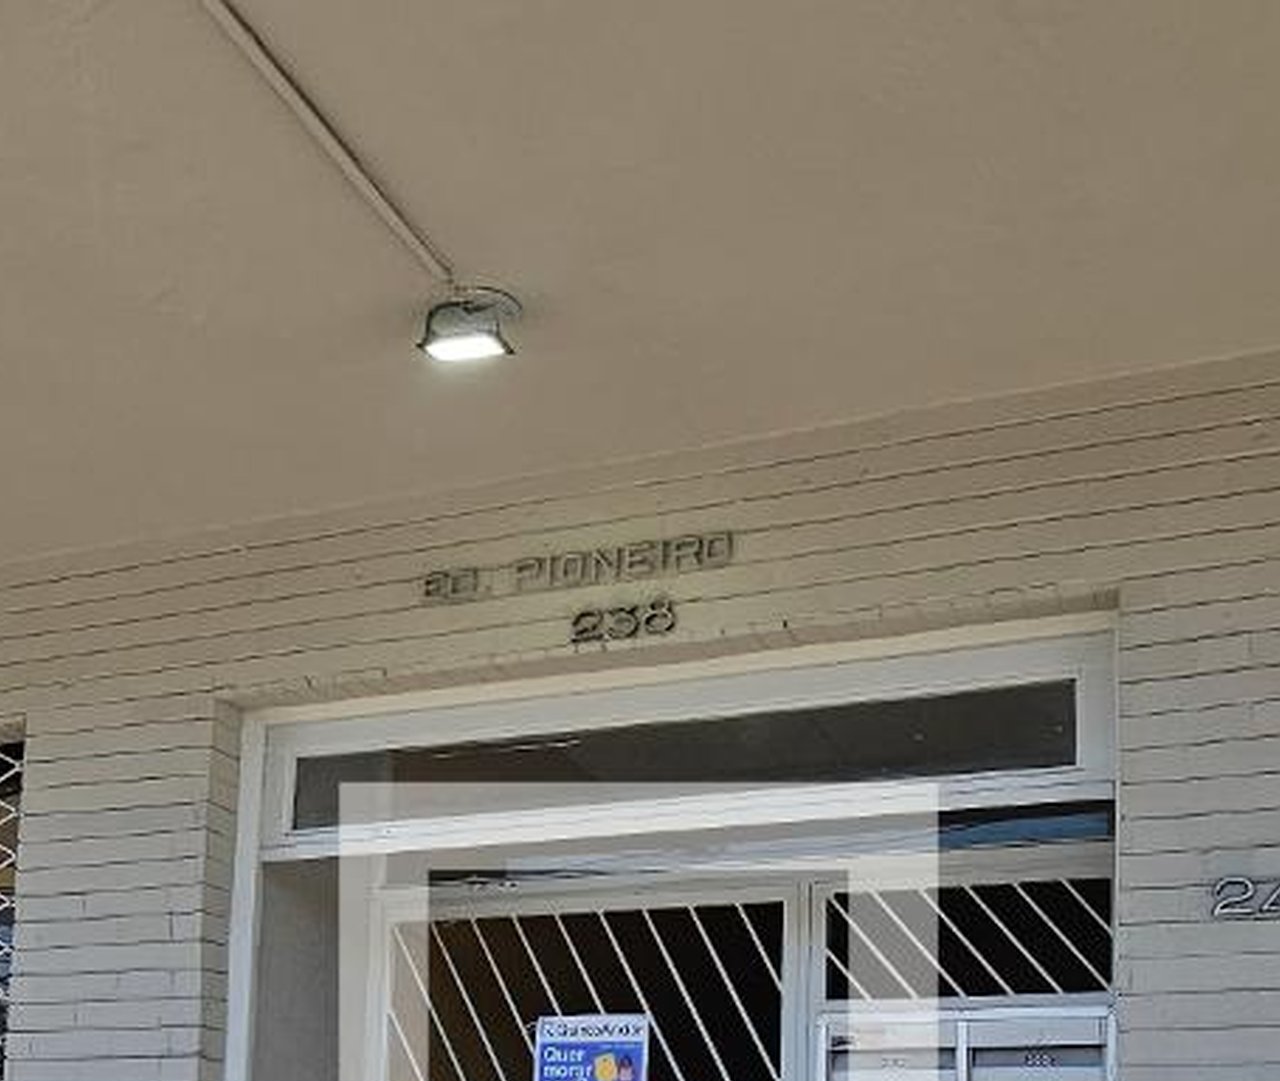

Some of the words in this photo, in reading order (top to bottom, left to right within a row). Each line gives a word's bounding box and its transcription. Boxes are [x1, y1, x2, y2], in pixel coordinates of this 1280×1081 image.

[515, 531, 734, 592] PIONEIRO
[570, 601, 676, 645] 238
[543, 1046, 587, 1063] Quer
[543, 1063, 593, 1078] morar
